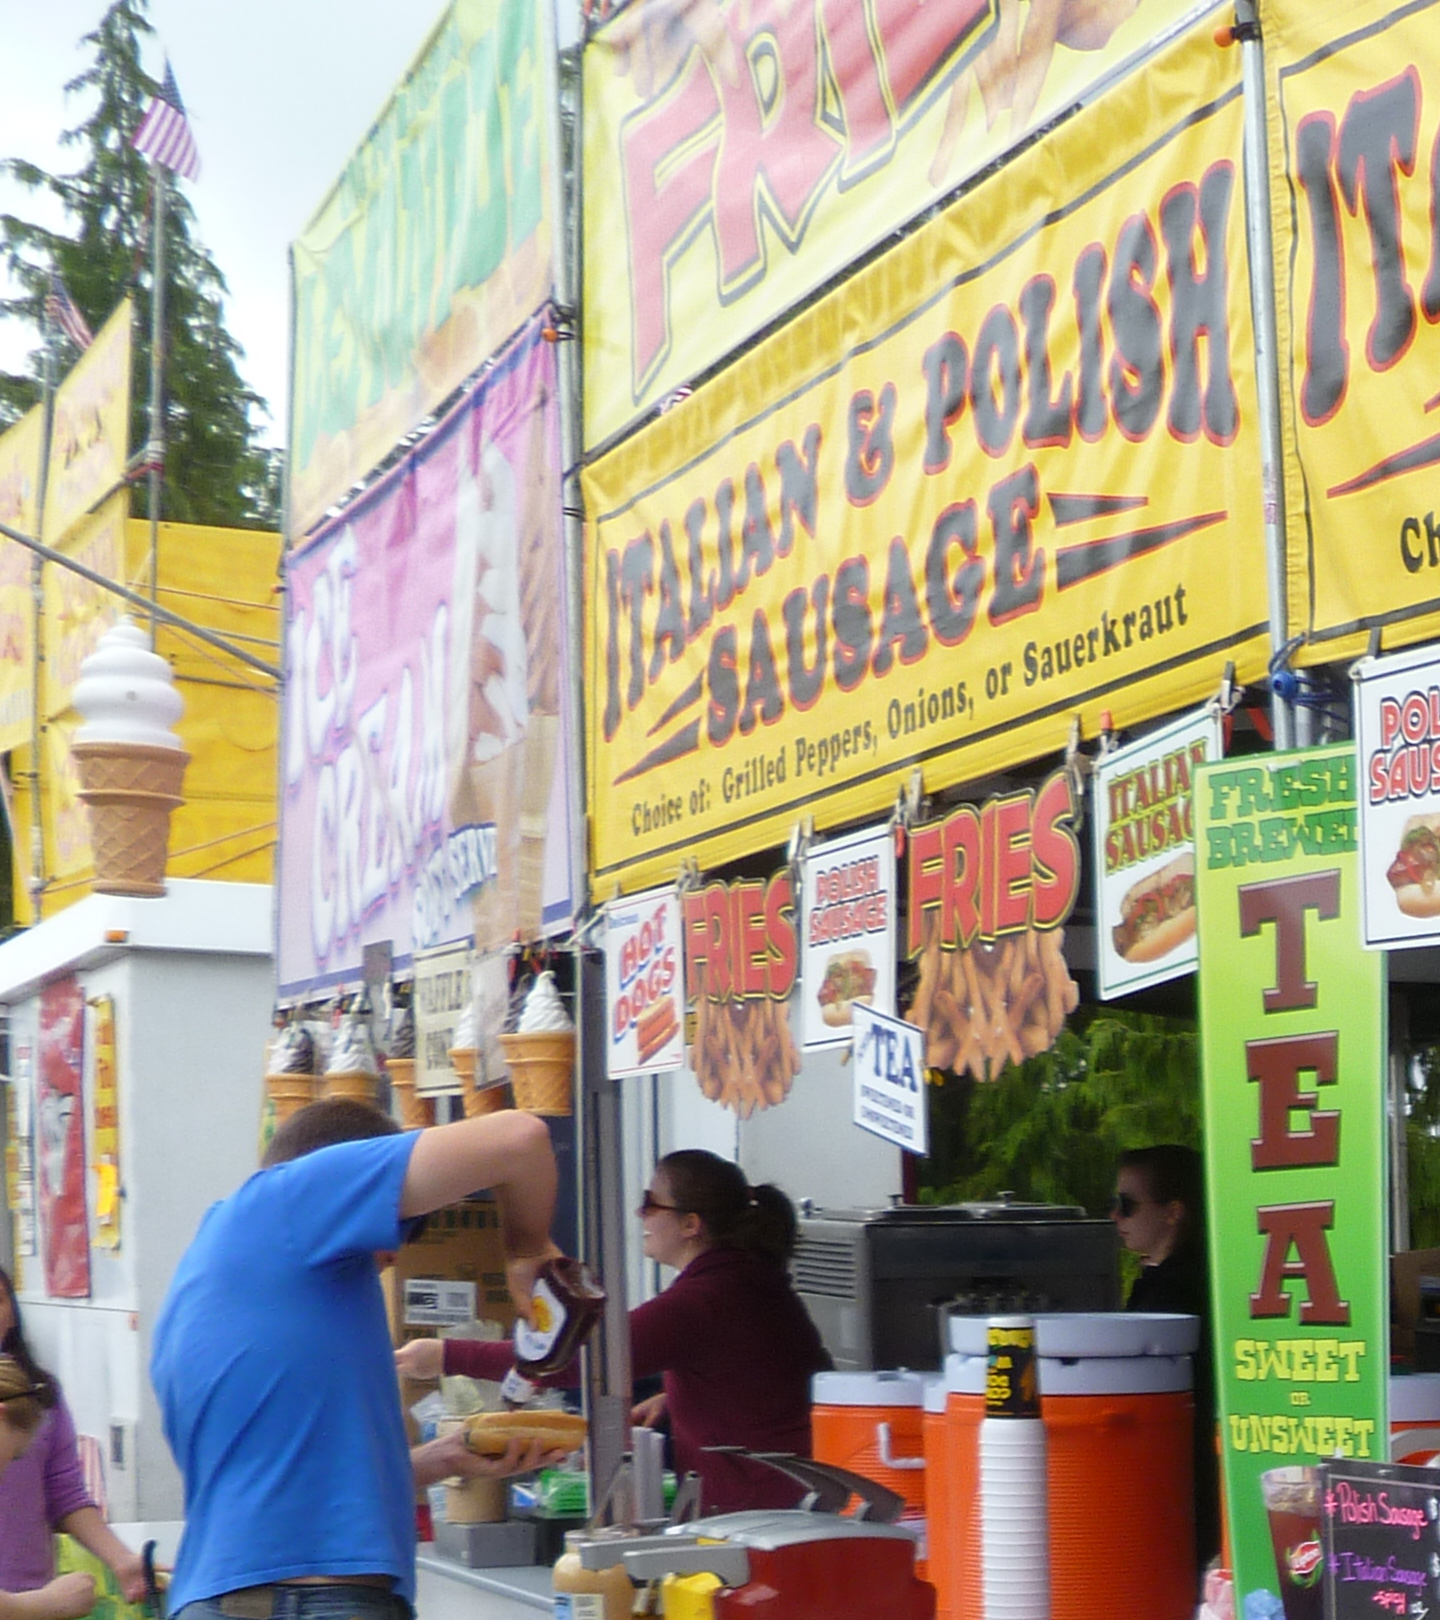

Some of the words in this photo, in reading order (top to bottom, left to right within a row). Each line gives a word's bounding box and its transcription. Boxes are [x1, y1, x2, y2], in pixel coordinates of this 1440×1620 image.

[603, 422, 822, 744] ITALIAN
[844, 381, 898, 508] &
[922, 158, 1241, 476] POLISH
[705, 461, 1050, 748] SAUSAGE
[631, 789, 684, 838] Choice
[689, 779, 712, 811] of:
[722, 755, 788, 804] Grilled
[795, 728, 878, 784] Peppers,
[887, 684, 975, 741] Onions,
[985, 660, 1013, 699] or
[1024, 583, 1188, 687] Sauerkraut
[816, 855, 879, 905] POLISH
[908, 772, 1080, 960] FRIES
[621, 903, 667, 985] HOT
[684, 867, 798, 1003] FRIES
[809, 890, 888, 947] SAUSAGE
[614, 946, 676, 1038] DOGS
[871, 1022, 918, 1093] TEA
[1236, 868, 1351, 1326] TEA
[1233, 1338, 1368, 1383] SWEET
[1230, 1414, 1374, 1459] UNSWEET
[1336, 1482, 1377, 1524] Polish
[1377, 1492, 1428, 1540] Sausage
[1339, 1552, 1388, 1582] Italian
